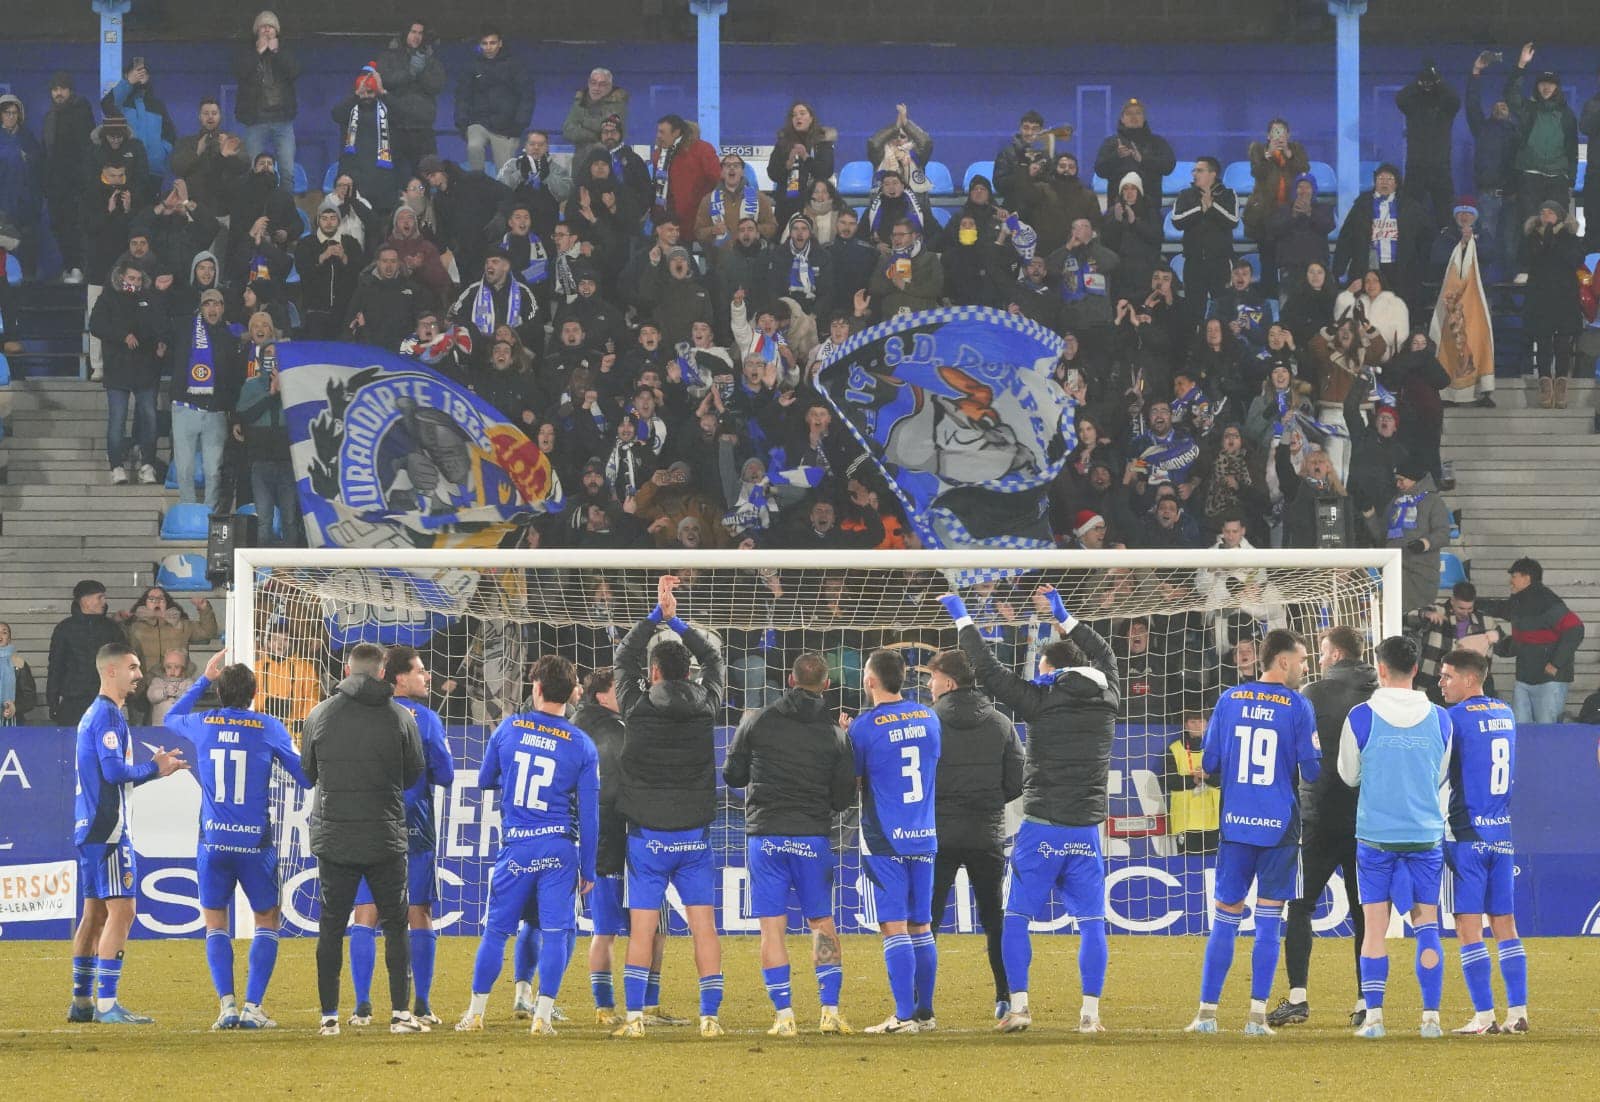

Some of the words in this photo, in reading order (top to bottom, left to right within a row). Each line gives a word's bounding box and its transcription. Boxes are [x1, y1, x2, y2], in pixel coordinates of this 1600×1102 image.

[1231, 691, 1254, 700] CAJA
[204, 716, 225, 725] CAJA
[512, 719, 535, 730] CAJA
[874, 713, 898, 726] CAJA
[218, 731, 240, 743] MULA
[520, 733, 557, 751] JURGENS
[1235, 725, 1278, 786] 19
[1490, 738, 1510, 795] 8
[210, 749, 247, 804] 11
[514, 751, 556, 812] 12
[901, 745, 923, 804] 3
[214, 823, 262, 833] VALCARCE
[1232, 815, 1282, 828] VALCARCE
[519, 825, 565, 838] VALCARCE
[123, 847, 133, 867] 5
[2, 871, 71, 899] ERSUS
